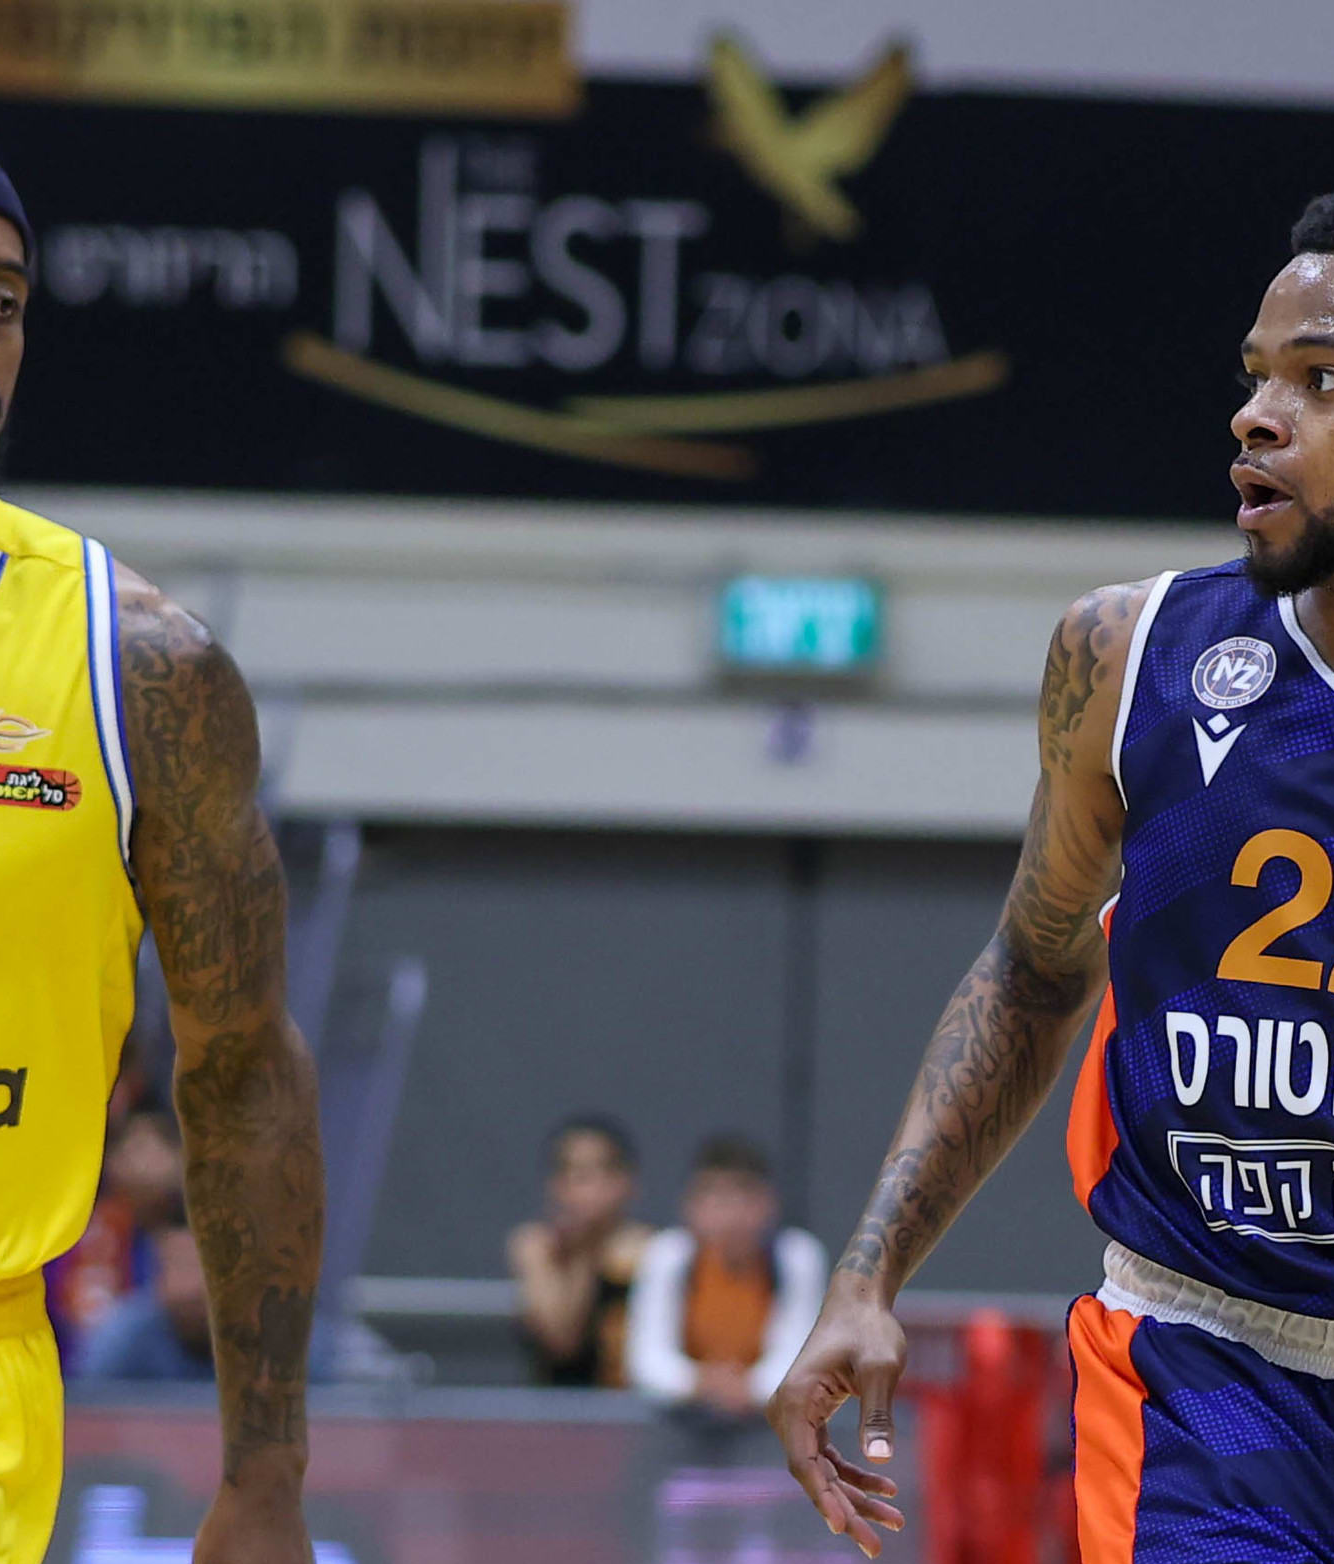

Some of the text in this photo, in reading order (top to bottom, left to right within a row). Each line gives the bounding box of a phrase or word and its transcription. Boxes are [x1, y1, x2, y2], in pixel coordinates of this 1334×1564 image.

[334, 133, 710, 370] NEST
[1212, 655, 1260, 690] NZ
[1199, 1154, 1312, 1228] קפה
